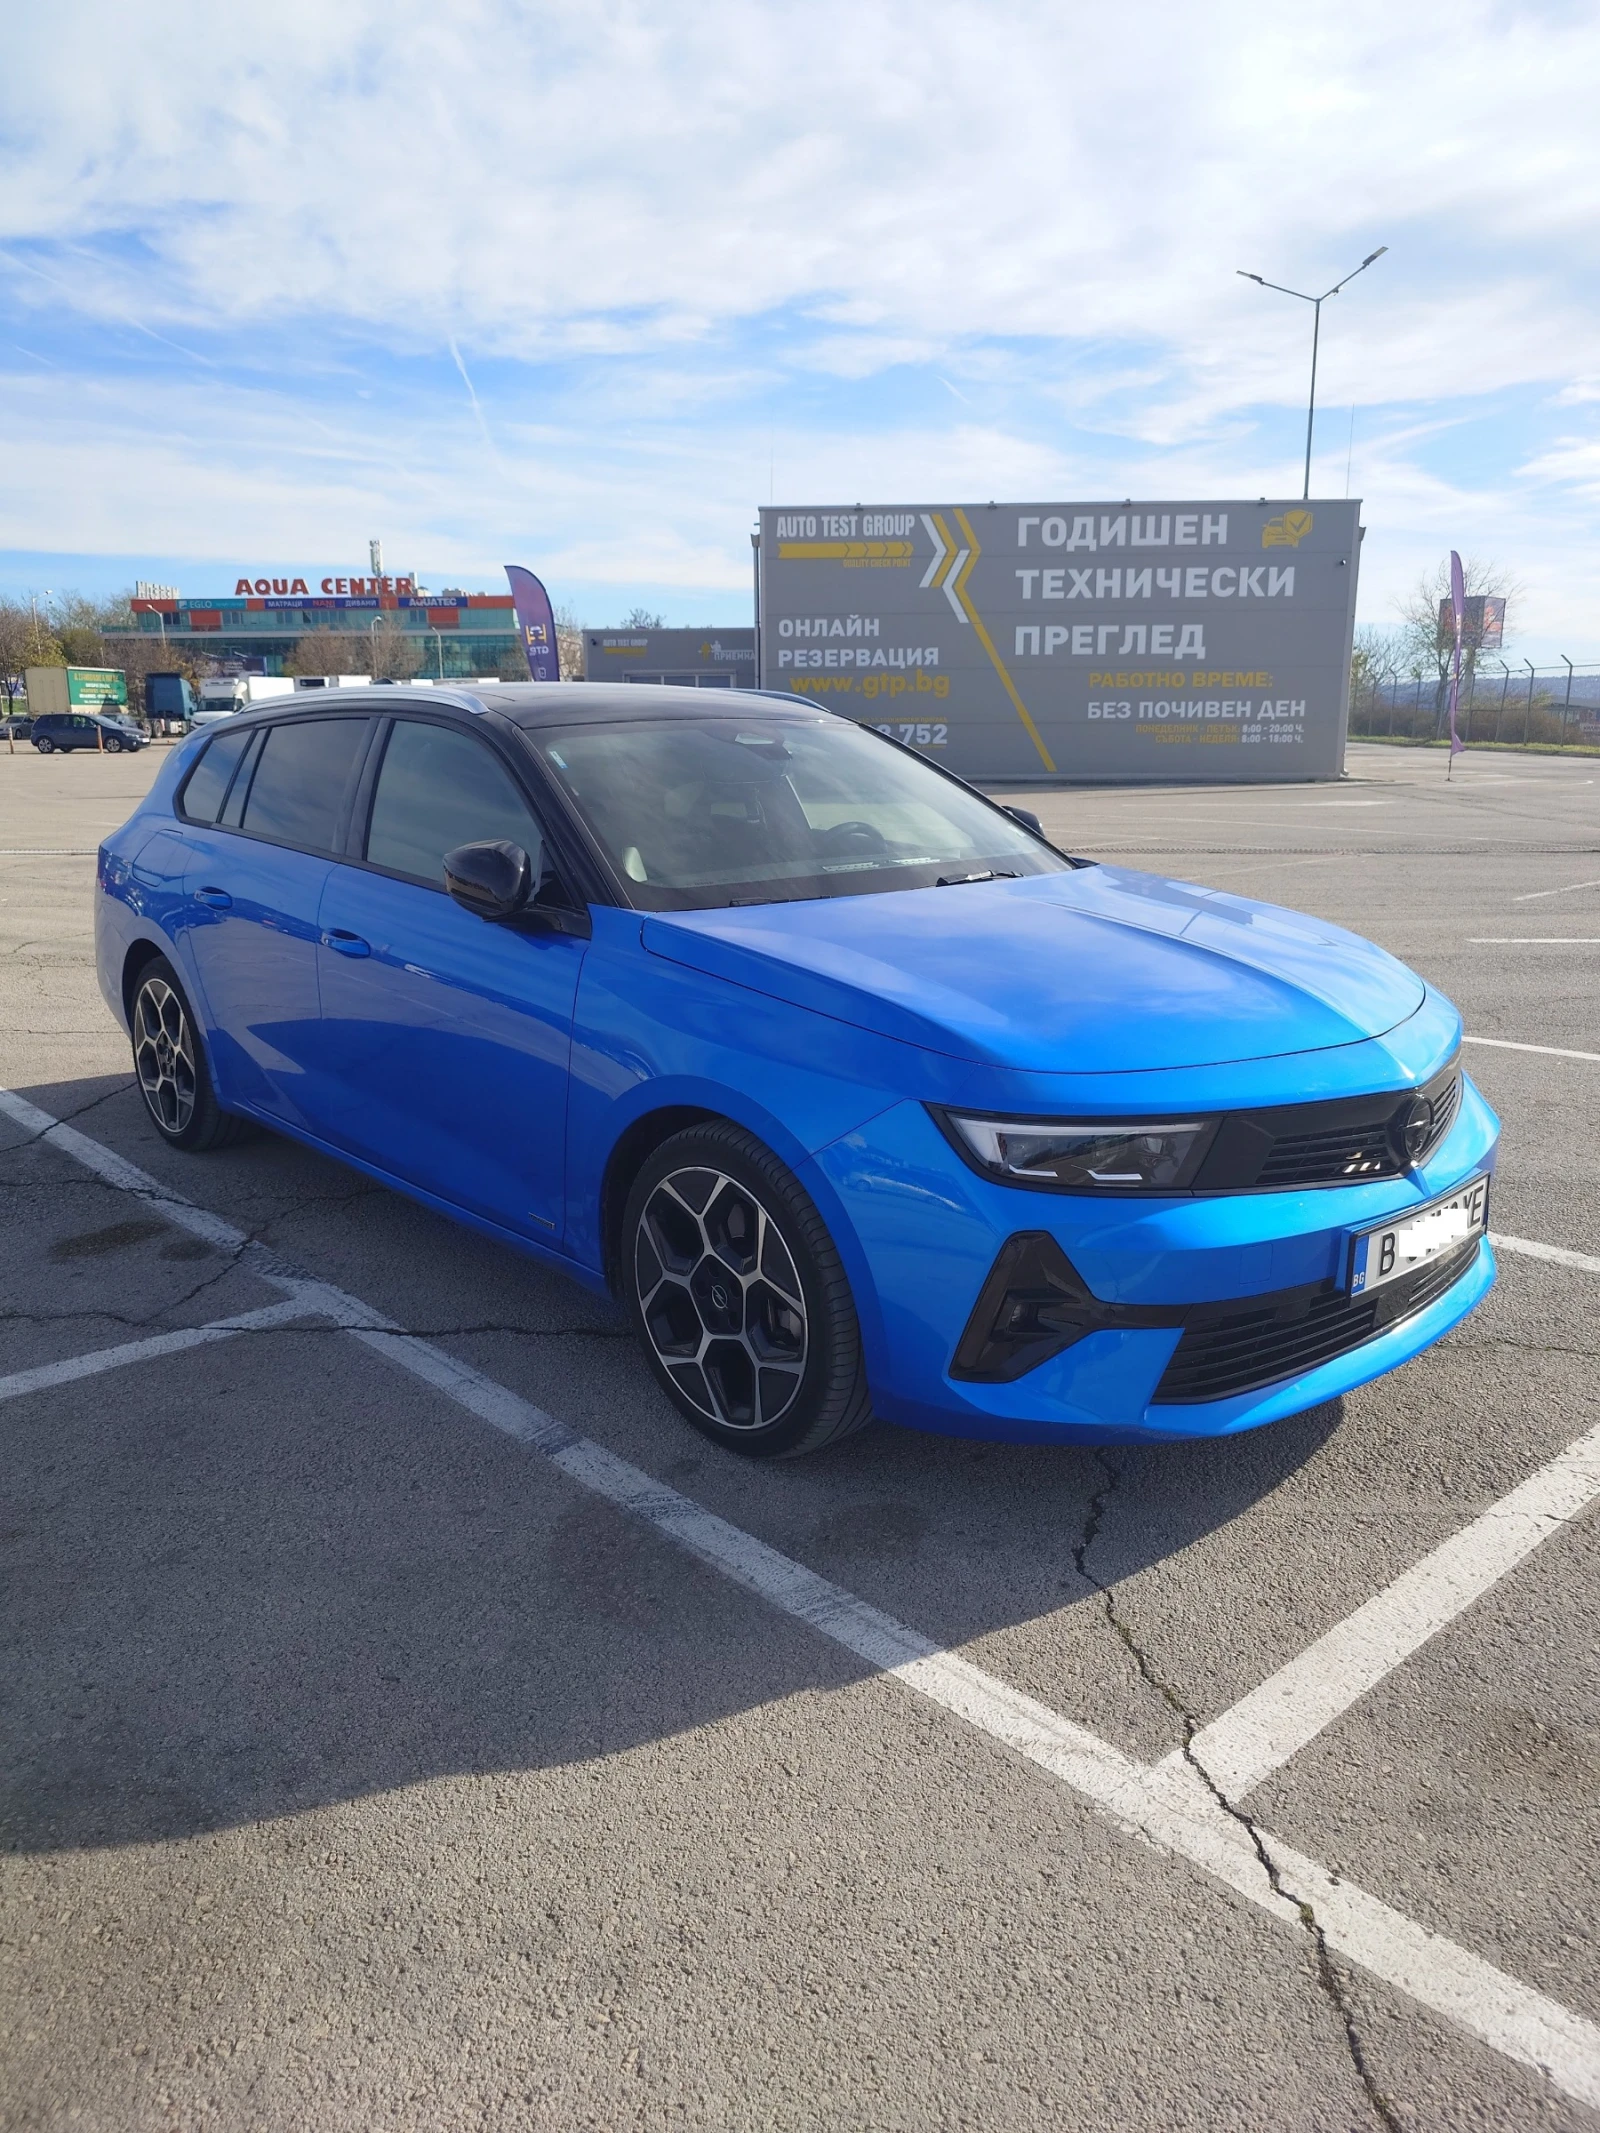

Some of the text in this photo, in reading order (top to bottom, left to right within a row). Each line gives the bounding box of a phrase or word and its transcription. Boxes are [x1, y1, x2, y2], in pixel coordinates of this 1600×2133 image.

[777, 514, 915, 537] AUTO TEST GROUP
[1017, 514, 1228, 552] ГОДИШЕН
[843, 559, 868, 567] QUALITY
[893, 558, 911, 567] POINT
[235, 577, 414, 596] AQUA CENTER
[1015, 566, 1295, 599] ТЕХНИЧЕСКИ
[189, 600, 212, 609] EGLO
[409, 598, 457, 607] AQUATEC
[779, 615, 880, 637] ОНЛАЙН
[1014, 624, 1206, 659] ПРЕГЛЕД
[778, 647, 939, 669] РЕЗЕРВАЦИЯ
[790, 669, 950, 699] www.gtp.bg
[1088, 672, 1273, 688] РАБОТНО ВРЕМЕ:
[1087, 700, 1306, 721] БЕЗ ПОЧИВЕН ДЕН
[899, 724, 947, 744] 752
[1136, 725, 1198, 733] ПОНЕДЕЛНИК
[1242, 724, 1261, 732] 8:00
[1269, 724, 1293, 732] 20:00
[1156, 735, 1192, 743] СЪБОТА
[1241, 735, 1260, 743] 8:00
[1269, 734, 1292, 743] 18:00
[1379, 1232, 1395, 1276] B
[1353, 1272, 1365, 1287] BG
